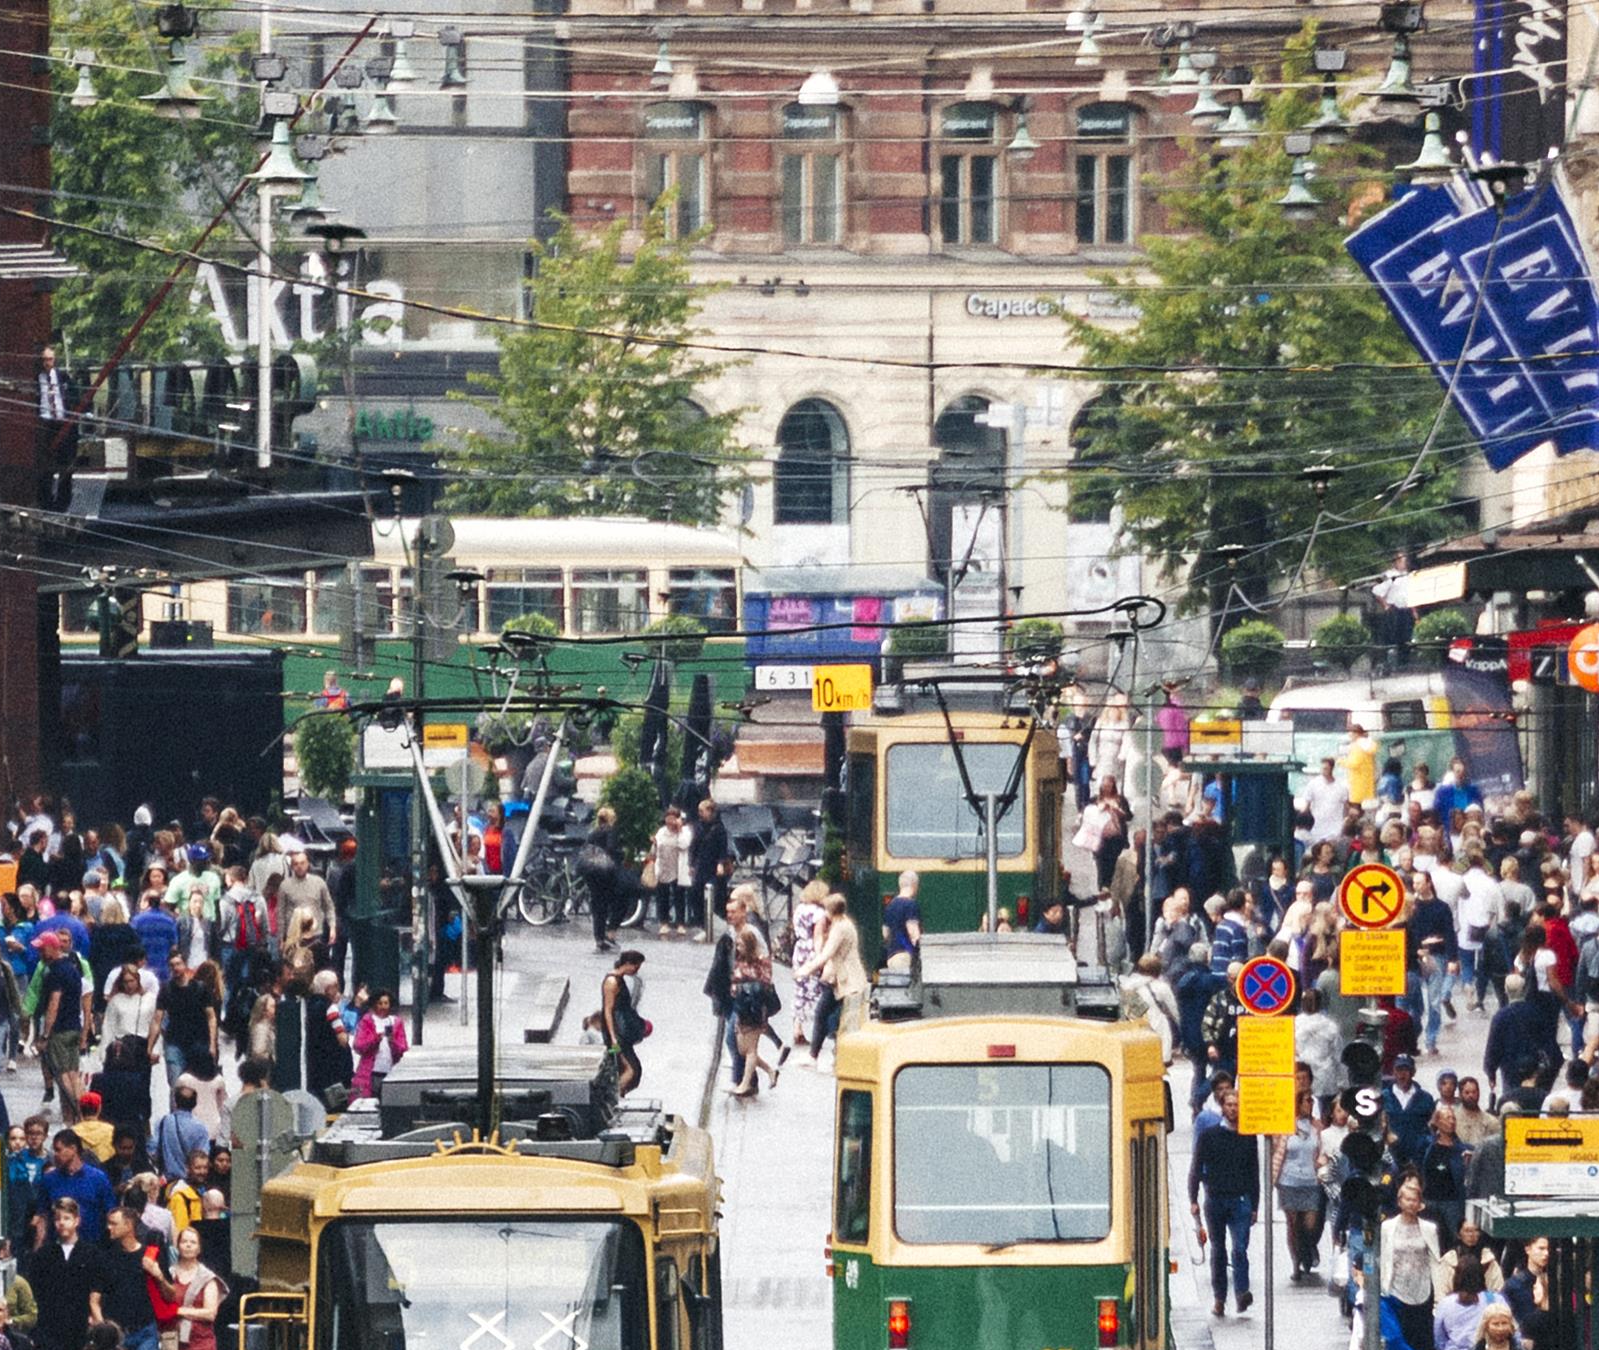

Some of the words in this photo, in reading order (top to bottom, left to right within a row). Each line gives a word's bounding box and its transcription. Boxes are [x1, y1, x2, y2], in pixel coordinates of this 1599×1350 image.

[189, 252, 405, 351] Aktia
[815, 678, 834, 707] 10
[836, 693, 869, 707] km/h
